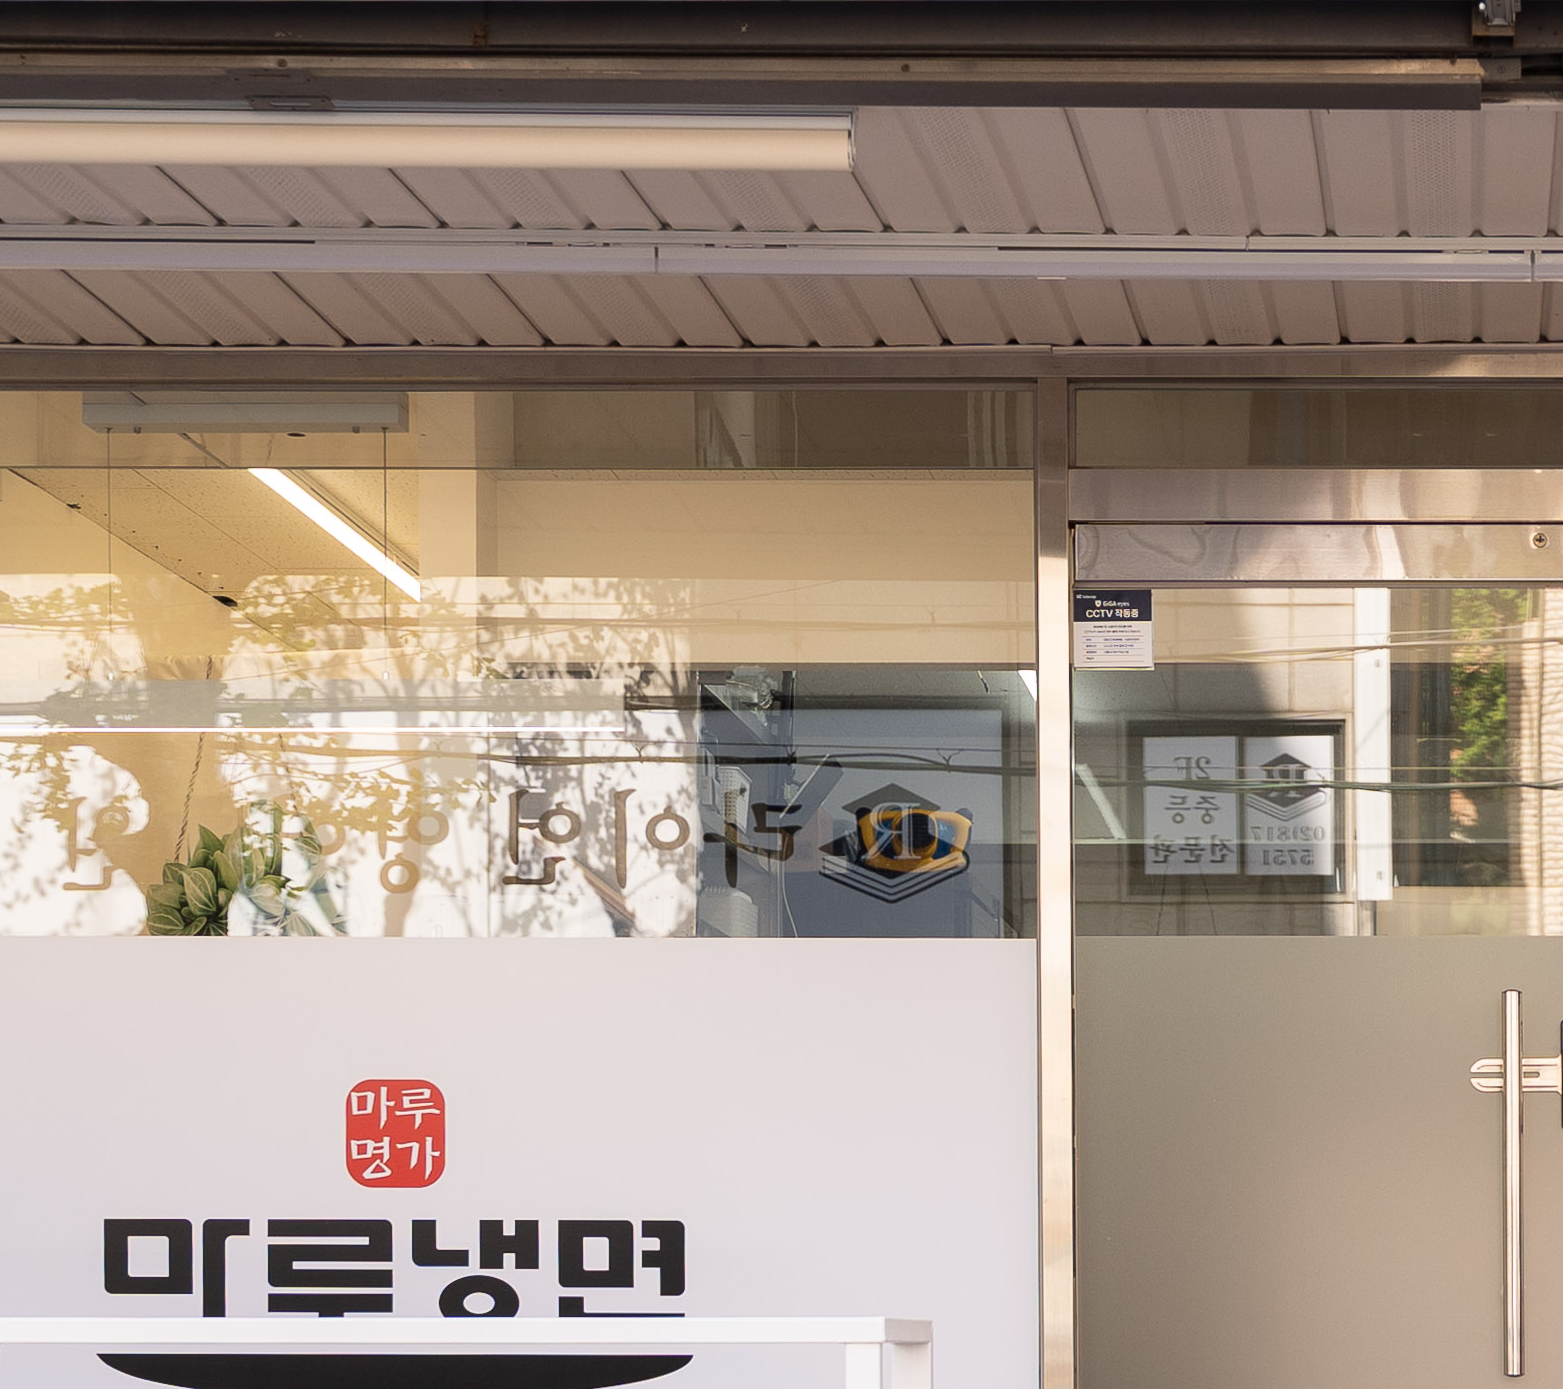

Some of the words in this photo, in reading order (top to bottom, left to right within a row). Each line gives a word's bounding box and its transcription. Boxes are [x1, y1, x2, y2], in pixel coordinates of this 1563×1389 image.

[1085, 609, 1114, 618] CCTV
[1115, 608, 1139, 618] 작동중
[348, 1085, 441, 1131] 마루
[348, 1135, 441, 1181] 명가
[103, 1218, 686, 1317] 마루냉면
